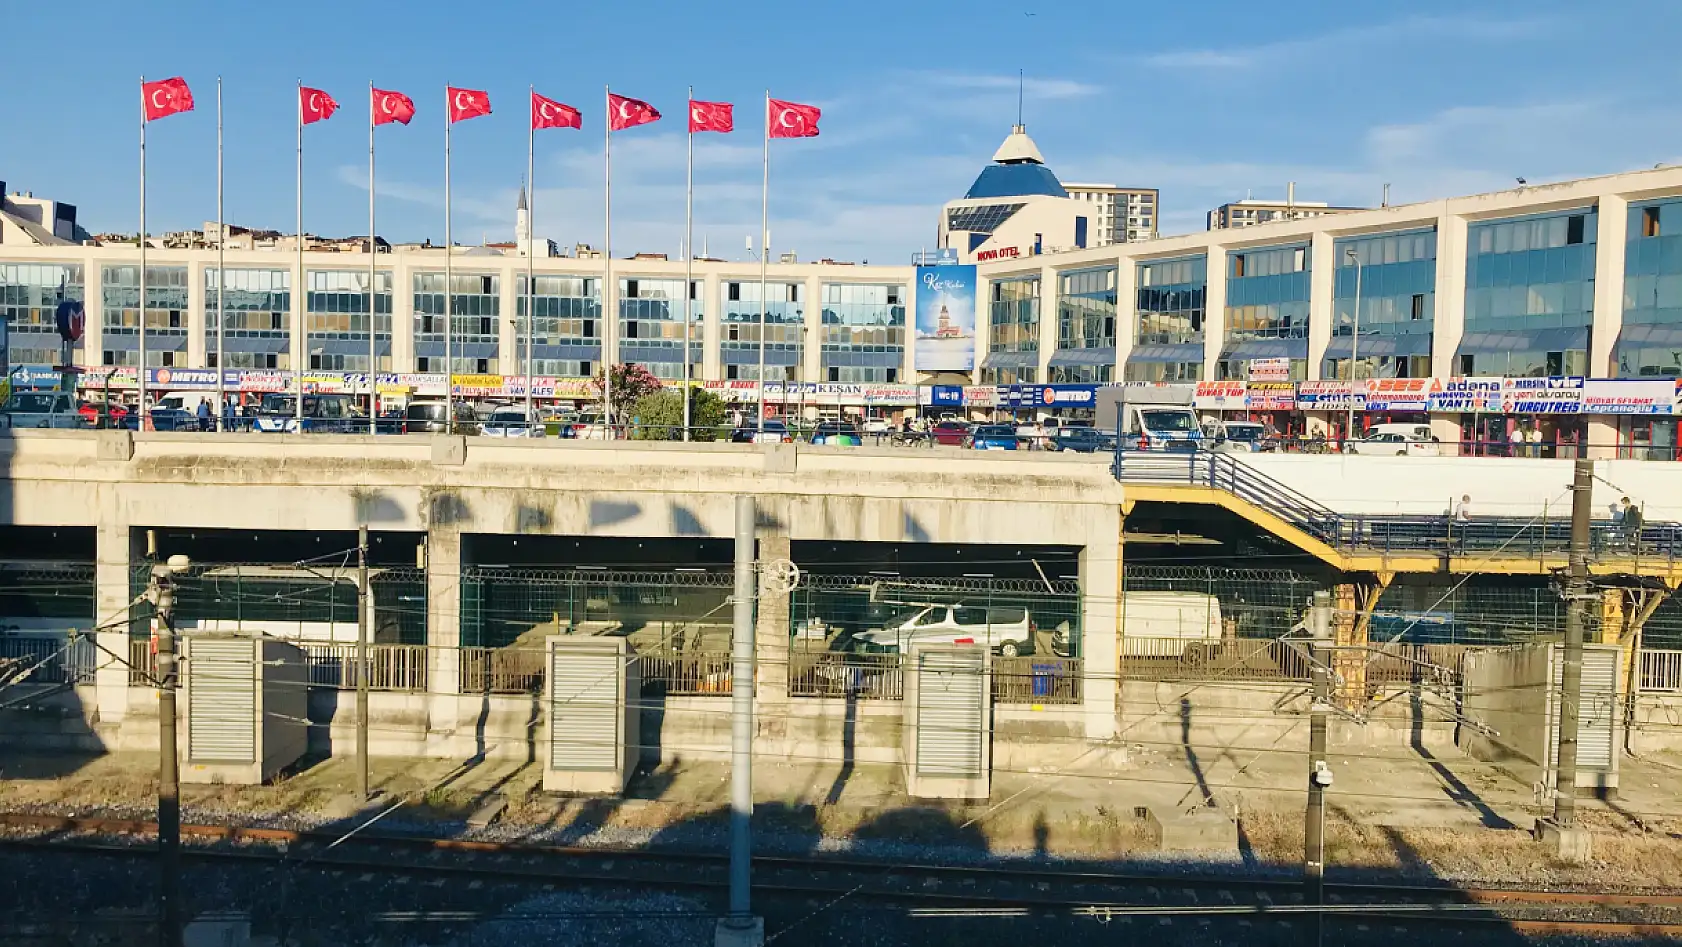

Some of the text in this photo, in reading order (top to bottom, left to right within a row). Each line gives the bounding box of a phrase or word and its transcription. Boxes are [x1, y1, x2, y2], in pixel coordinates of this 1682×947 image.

[978, 246, 1020, 261] NOVA OTEL
[171, 372, 217, 382] METRO
[1377, 380, 1425, 391] SES
[1447, 379, 1500, 391] adana
[1513, 388, 1581, 401] yeni aksaray
[1438, 399, 1464, 408] VAN
